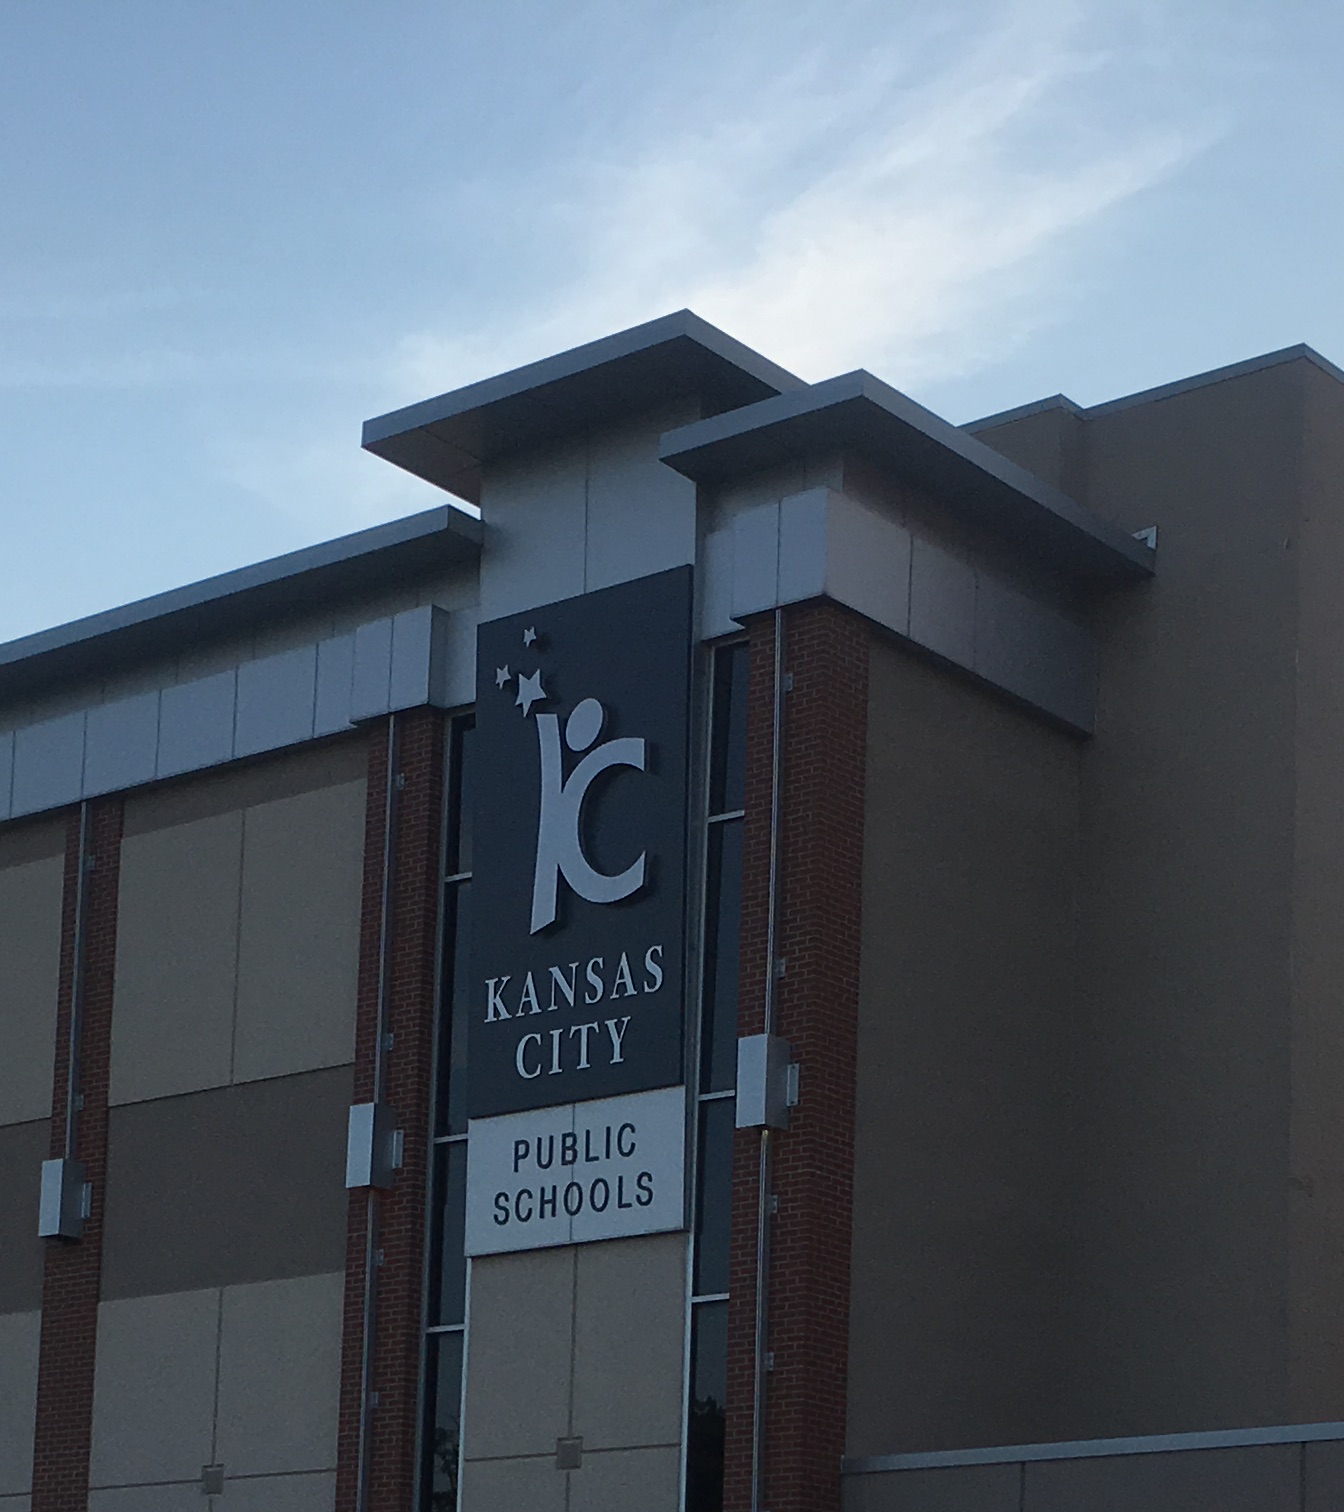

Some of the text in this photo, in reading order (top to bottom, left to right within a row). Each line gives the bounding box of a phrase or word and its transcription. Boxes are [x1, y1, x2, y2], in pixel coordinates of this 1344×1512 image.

[484, 945, 664, 1023] KANSAS
[515, 1016, 632, 1079] CITY
[513, 1123, 636, 1172] PUBLIC
[493, 1171, 654, 1225] SCHOOLS
